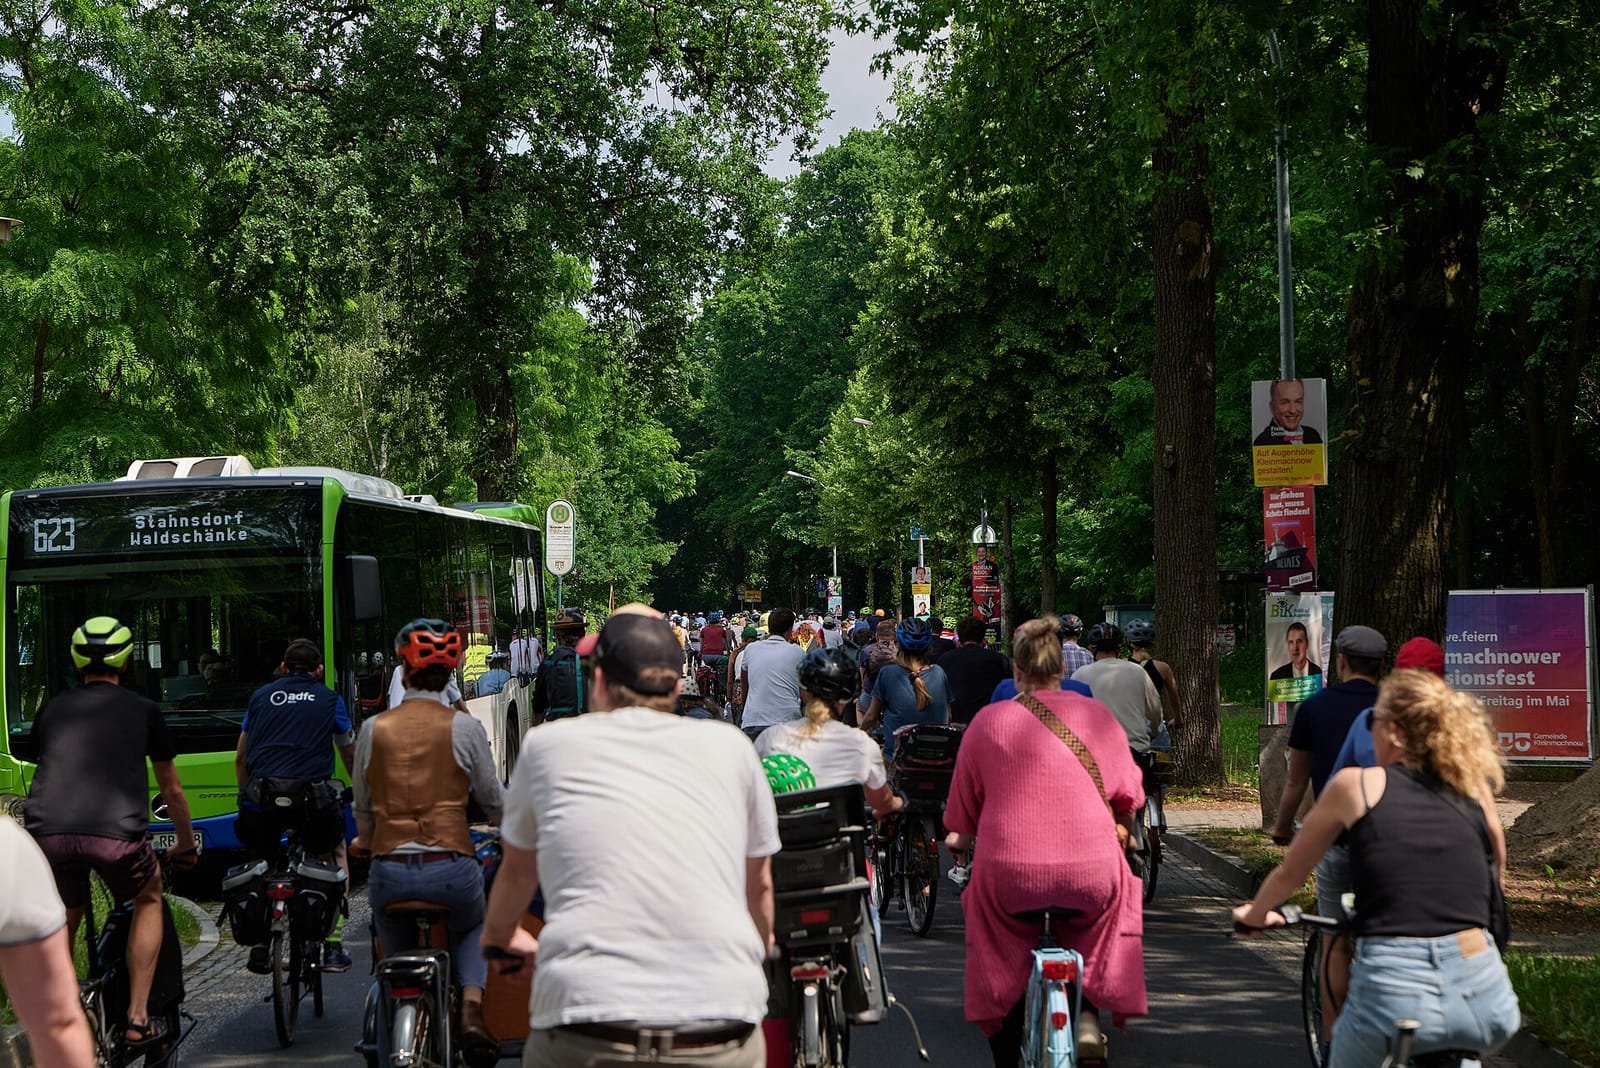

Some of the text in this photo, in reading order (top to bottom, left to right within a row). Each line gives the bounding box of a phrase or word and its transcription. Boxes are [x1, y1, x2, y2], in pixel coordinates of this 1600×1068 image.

[1256, 448, 1315, 458] Auf Augenhöhe
[135, 511, 243, 529] Stahnsdorf
[34, 517, 75, 552] 623
[130, 528, 248, 546] Waldschänke
[1446, 647, 1561, 665] machnower
[1446, 669, 1536, 686] sionsfest
[287, 692, 316, 701] adfc
[1480, 695, 1570, 709] Freitag im Mai
